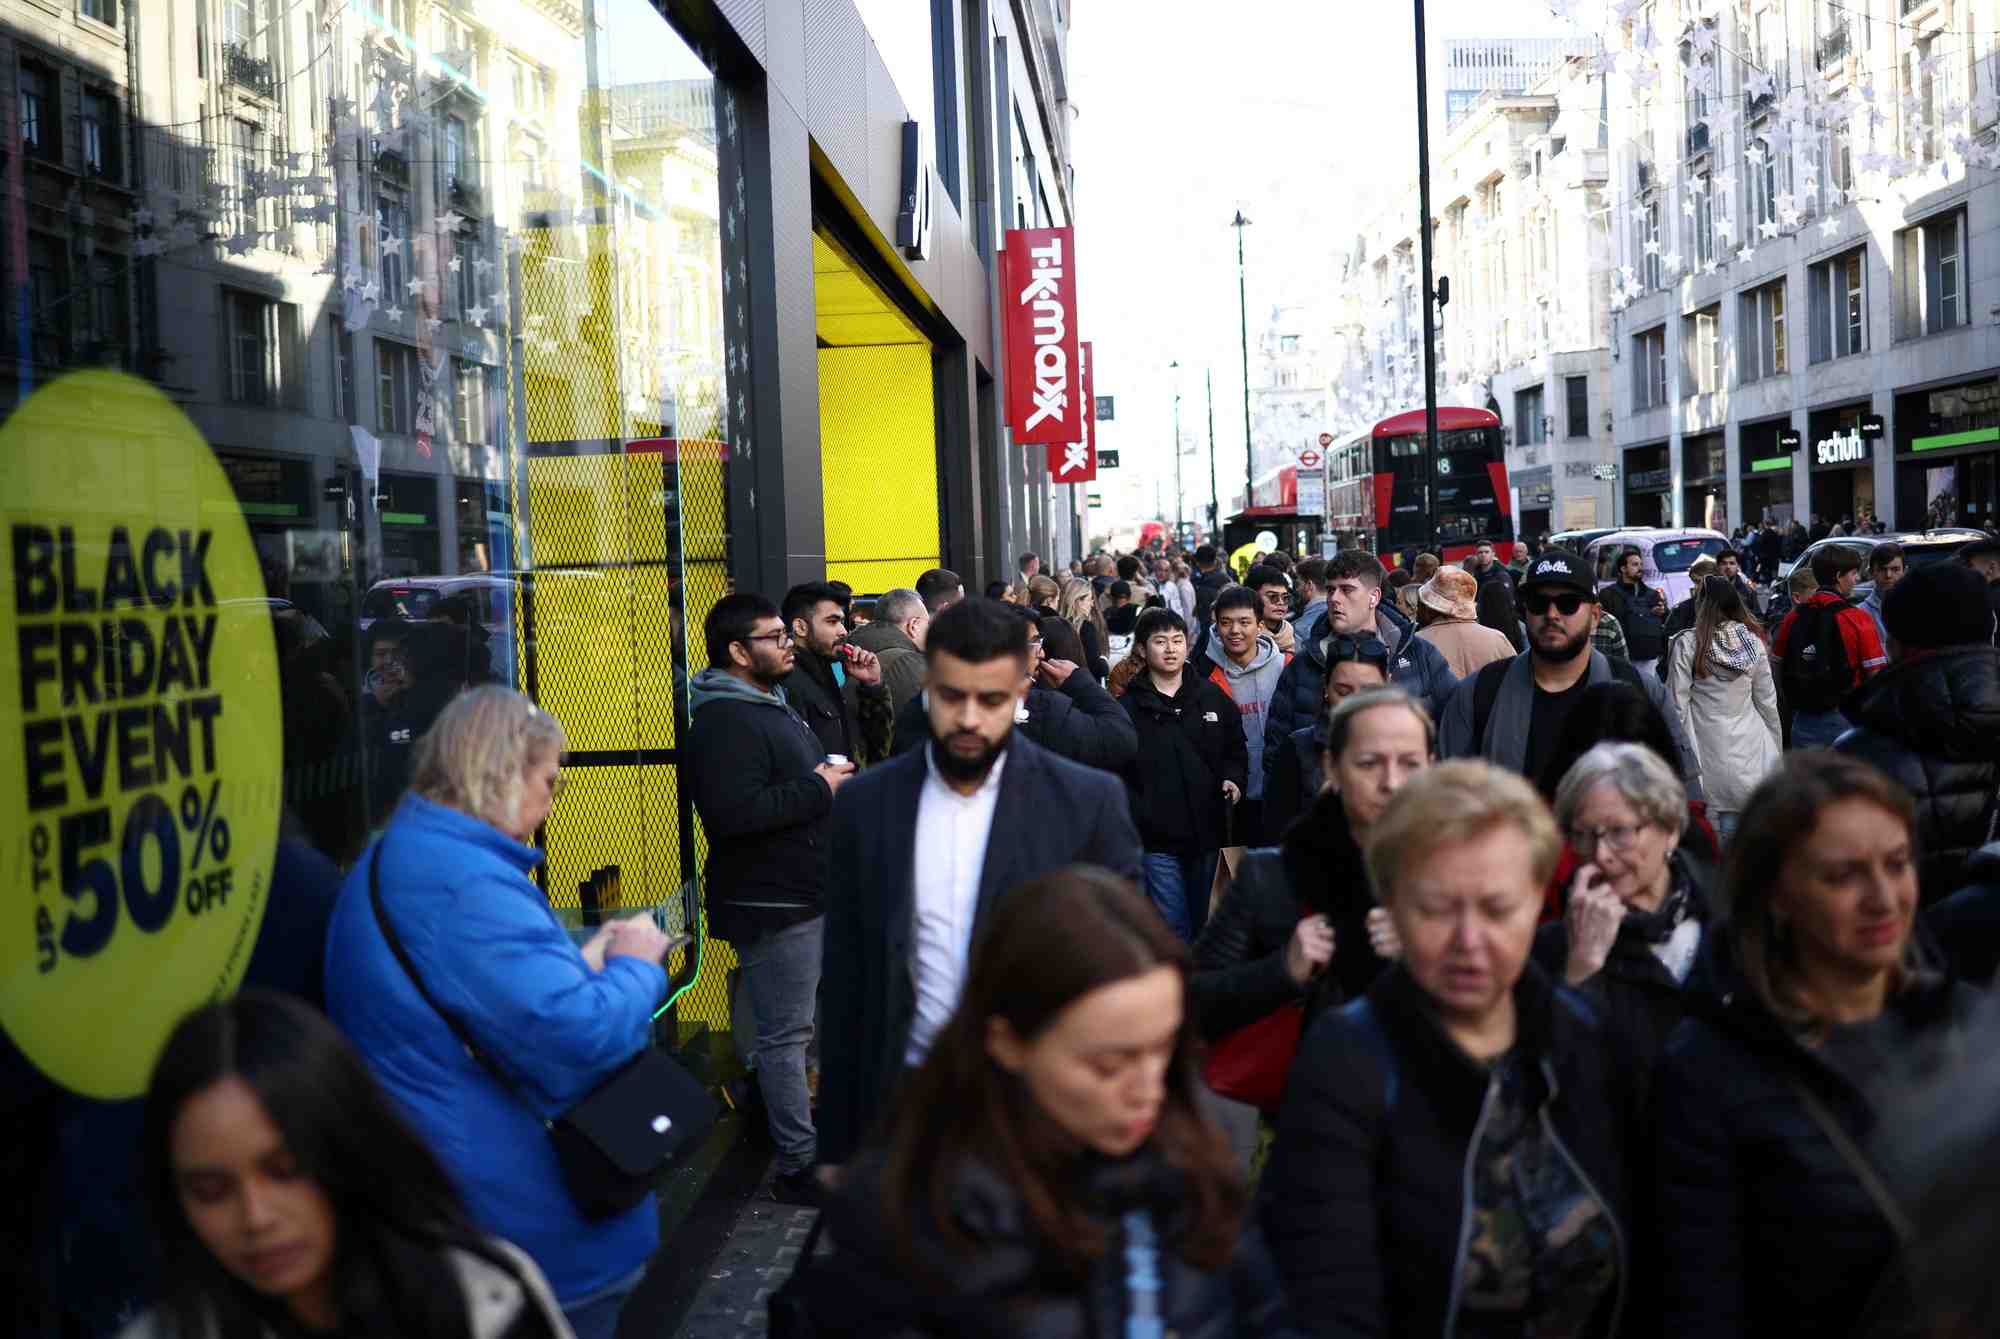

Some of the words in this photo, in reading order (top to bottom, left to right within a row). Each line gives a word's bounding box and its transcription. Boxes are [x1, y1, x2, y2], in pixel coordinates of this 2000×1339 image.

[1817, 428, 1863, 464] schuh
[12, 524, 216, 614] BLACK
[18, 613, 217, 713] FRIDAY
[24, 695, 222, 813] EVENT
[30, 822, 52, 893] TO
[186, 868, 233, 917] OFF
[35, 902, 58, 975] UP
